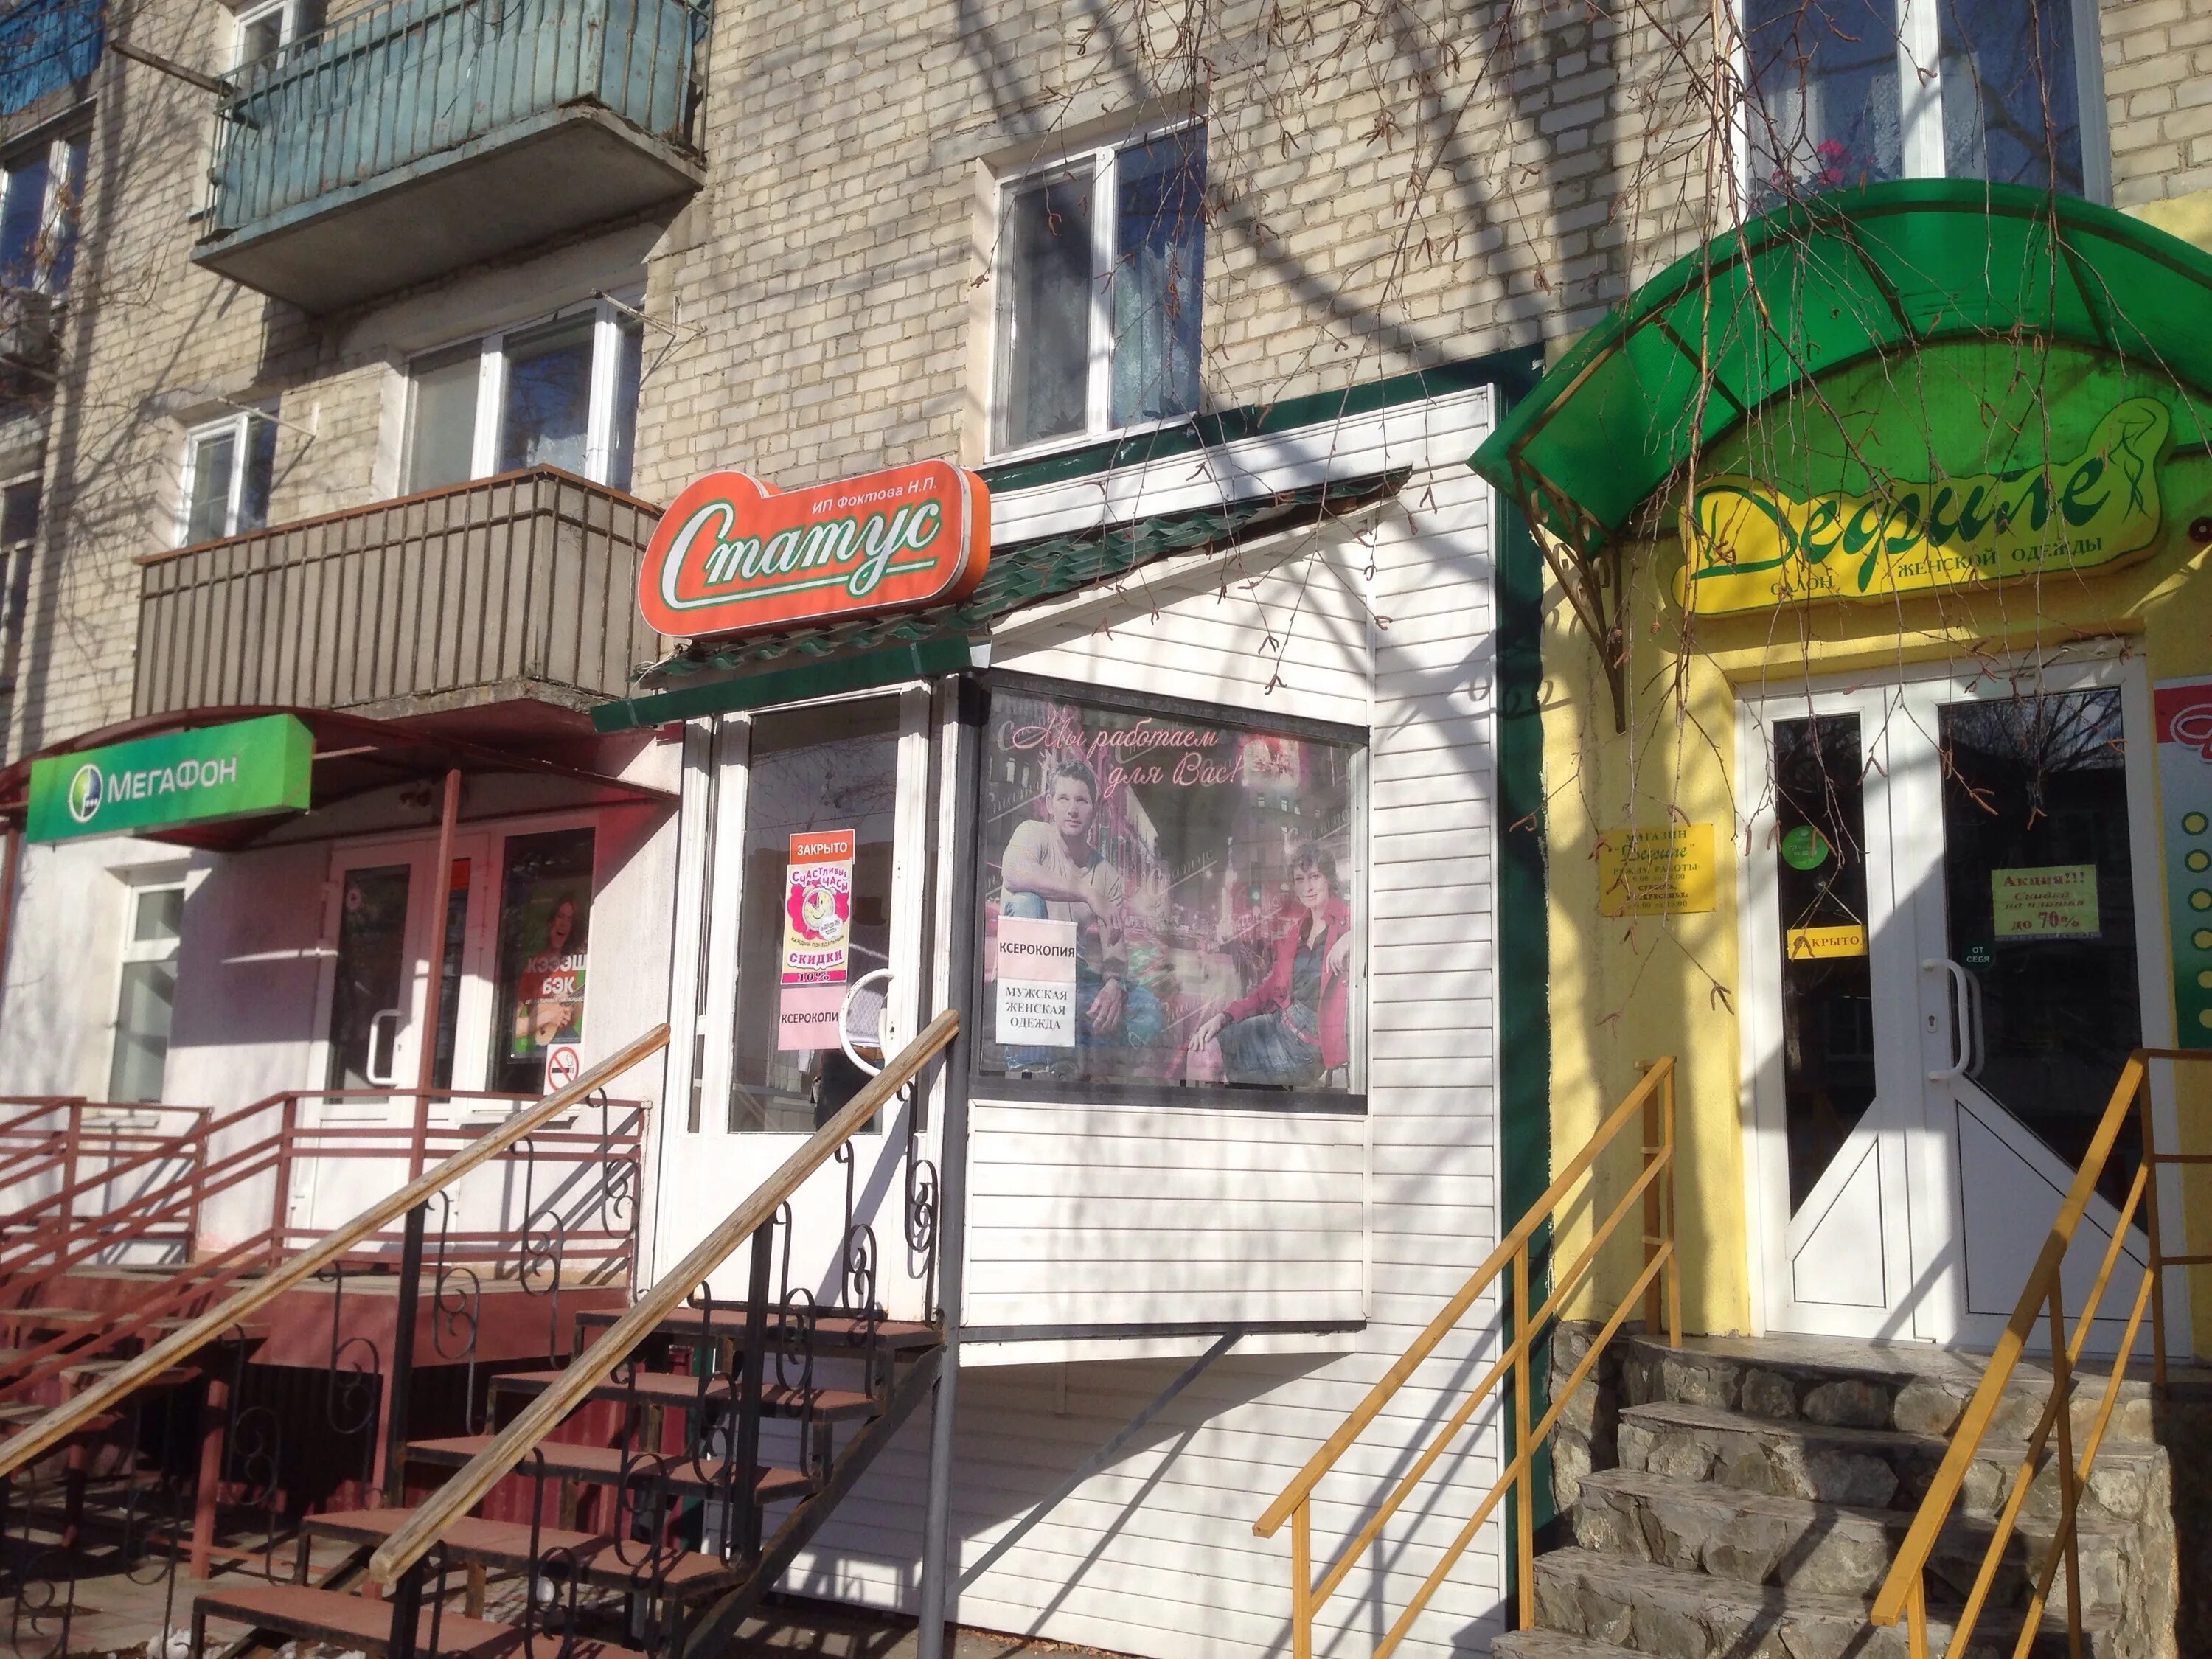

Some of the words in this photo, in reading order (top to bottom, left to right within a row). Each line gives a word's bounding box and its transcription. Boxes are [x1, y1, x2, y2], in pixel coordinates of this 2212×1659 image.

[811, 498, 834, 515] ИП
[837, 486, 903, 509] Фоктова
[908, 476, 937, 494] Н.П.
[1691, 457, 2111, 592] Дефиле
[660, 499, 943, 611] Статус
[1897, 549, 1997, 578] ЖЕНСКОЙ
[2011, 537, 2103, 563] ОДЕЖДЫ
[1086, 718, 1219, 759] работаем
[1103, 765, 1164, 799] для
[1173, 751, 1244, 787] Вас!
[1625, 830, 1687, 841] МАГАЗИН
[796, 841, 848, 856] ЗАКРЫТО
[822, 876, 848, 891] ЧАСЫ
[2003, 871, 2085, 887] Акция!!!
[2011, 919, 2032, 931] до
[2037, 911, 2080, 929] 70%
[998, 941, 1076, 958] КСЕРОКОПИЯ
[1795, 936, 1860, 948] КРЫТО
[527, 954, 588, 973] КЭЭЭШ
[789, 950, 843, 967] СКИДКИ
[797, 971, 830, 982] 10%
[1005, 987, 1068, 1001] МУЖСКАЯ
[1006, 1002, 1066, 1016] ЖЕНСКАЯ
[782, 1012, 840, 1025] КСЕРОКОПИ
[1009, 1017, 1062, 1031] ОДЕЖДА
